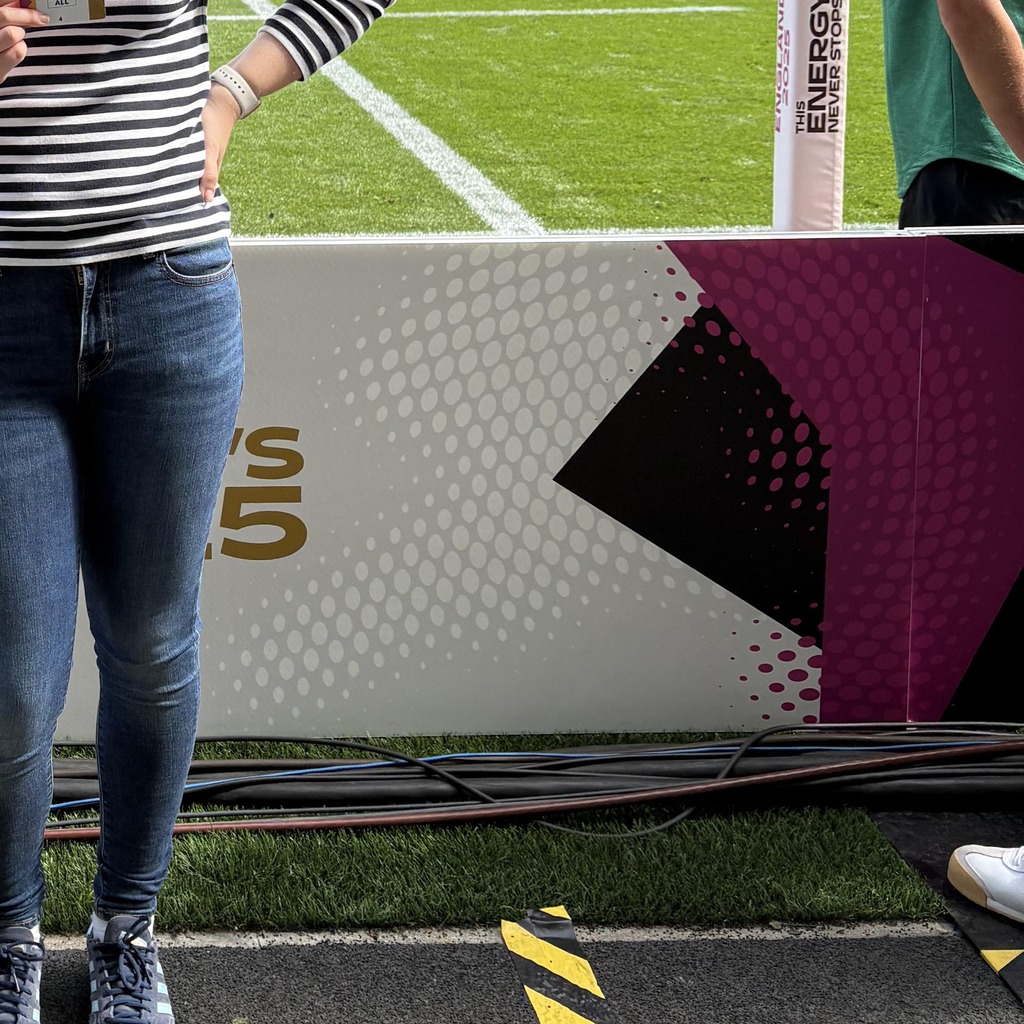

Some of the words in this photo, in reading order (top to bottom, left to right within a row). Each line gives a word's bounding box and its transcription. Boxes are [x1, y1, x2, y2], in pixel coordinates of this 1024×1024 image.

[782, 29, 791, 106] 2025
[828, 66, 841, 133] NEVER
[795, 101, 806, 134] THIS
